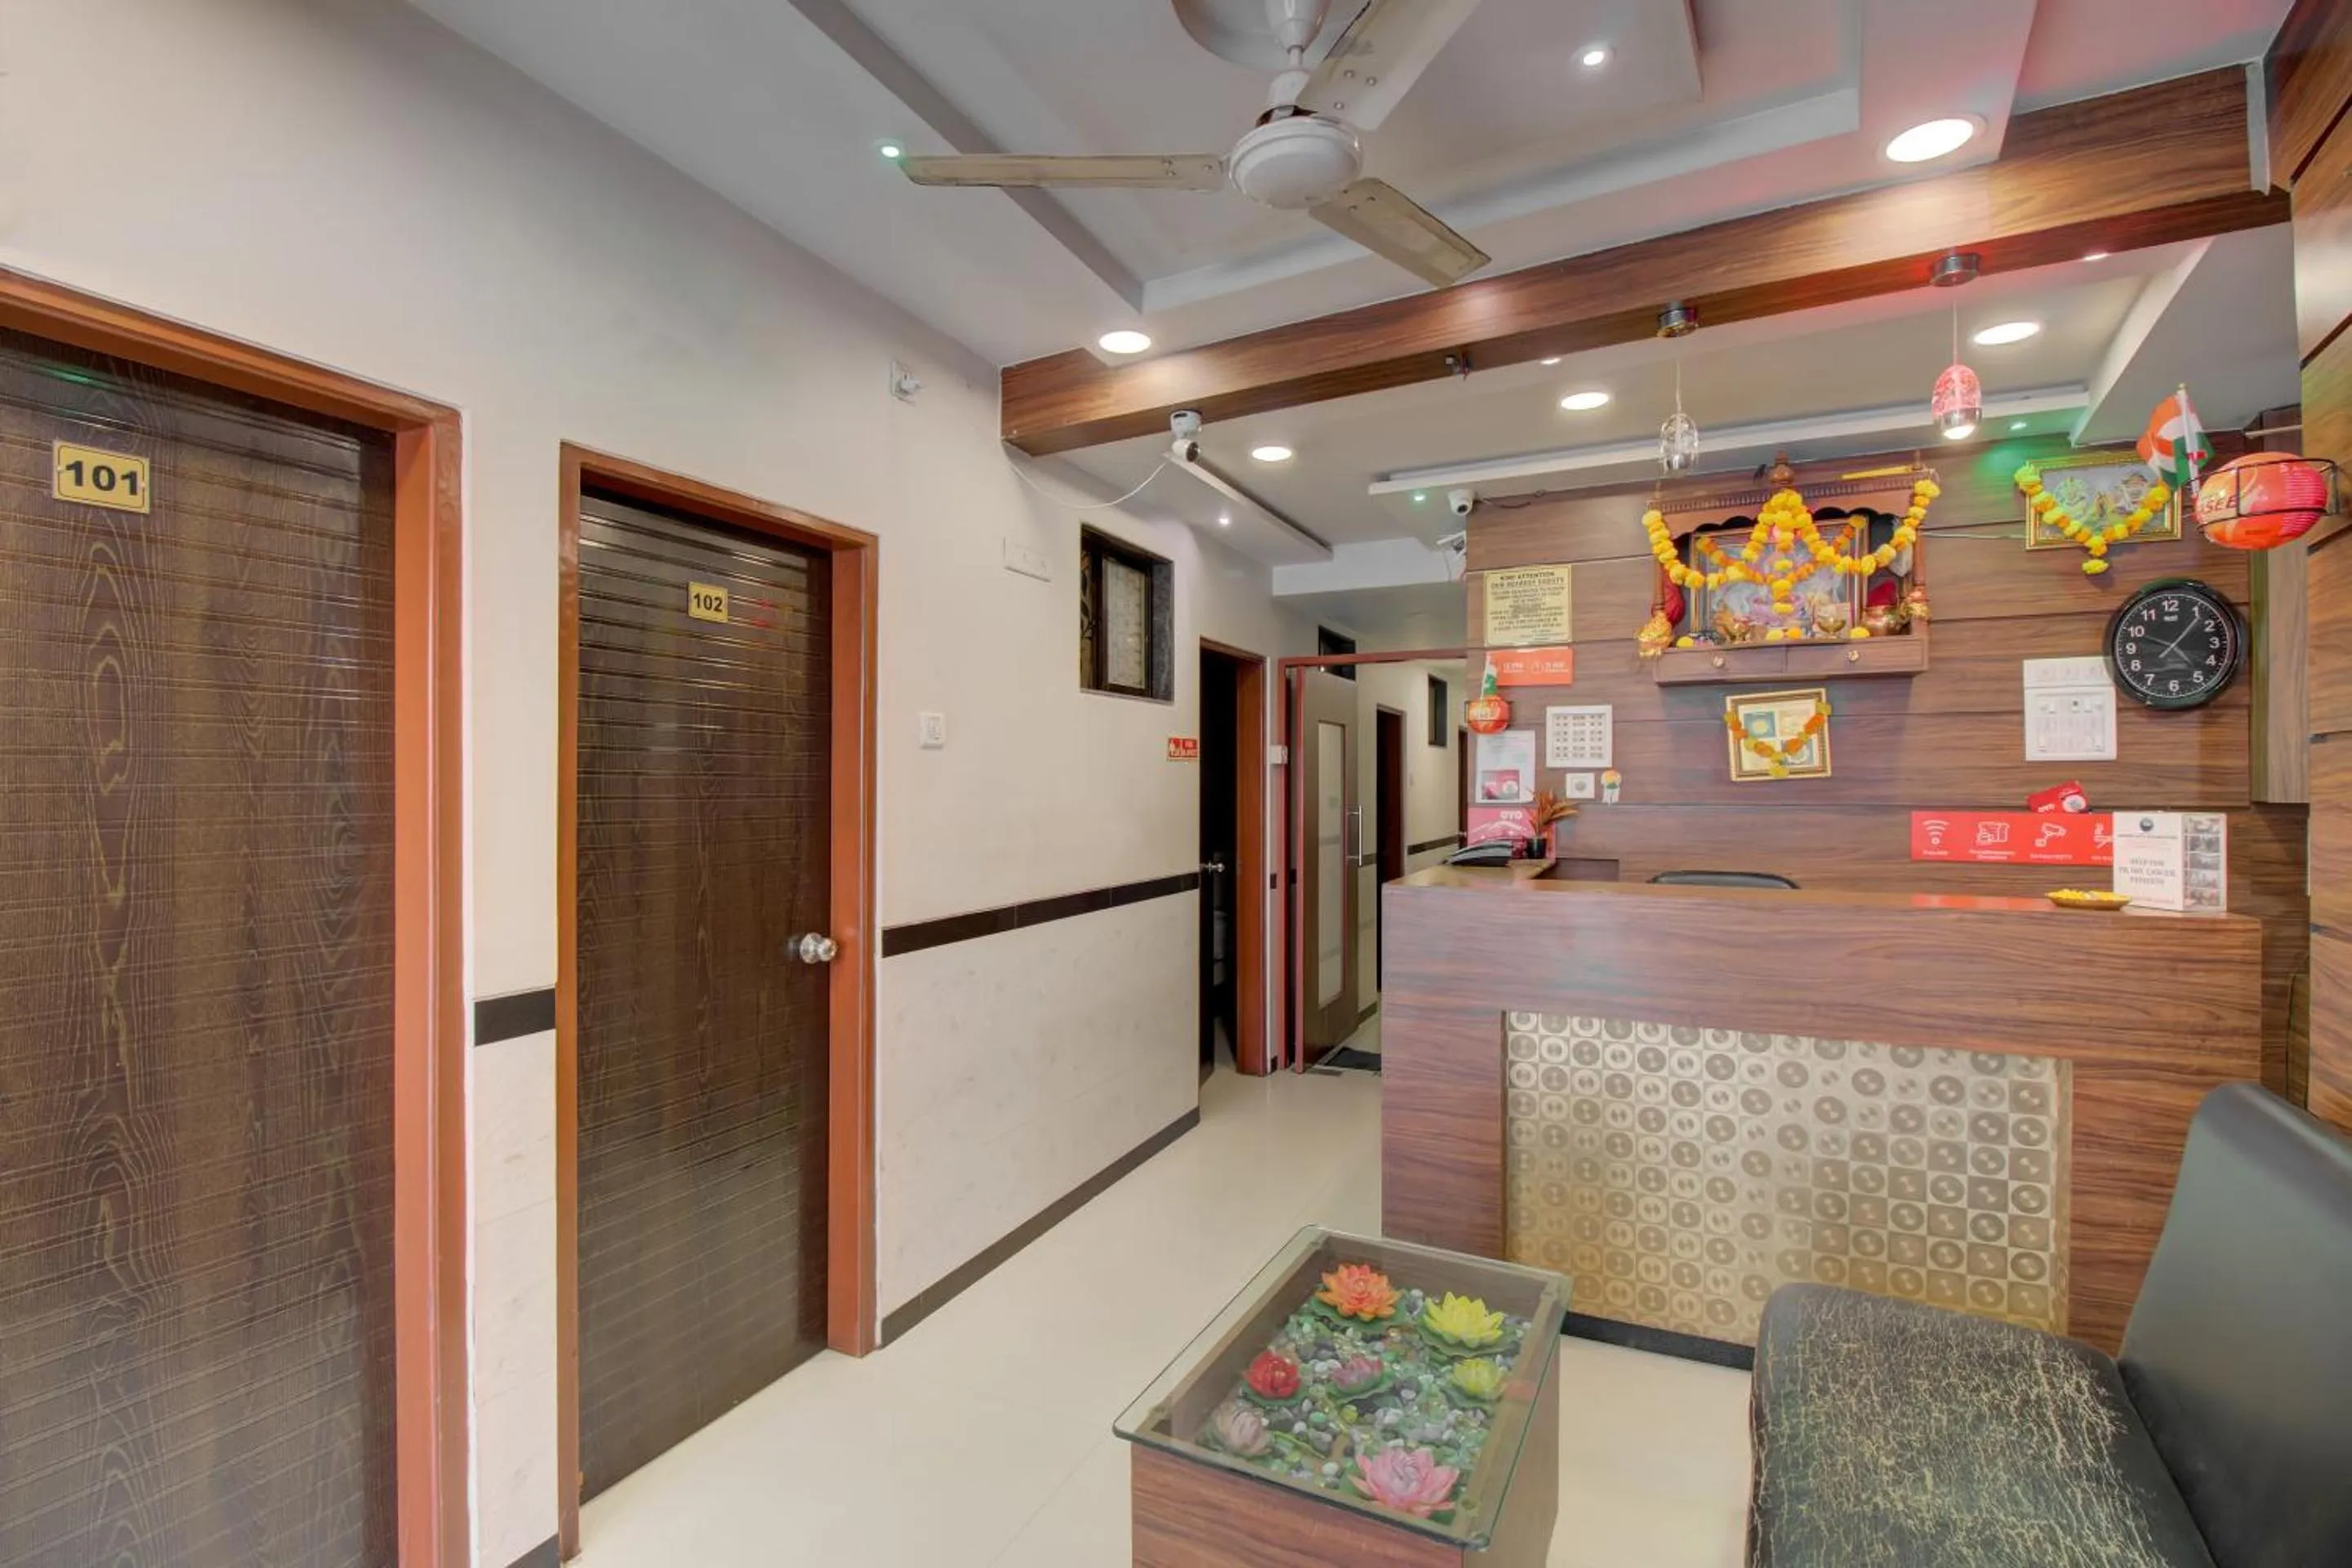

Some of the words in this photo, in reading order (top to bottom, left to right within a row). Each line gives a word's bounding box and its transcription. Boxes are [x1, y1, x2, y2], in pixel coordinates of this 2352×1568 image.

[65, 459, 139, 497] 101
[693, 592, 724, 613] 102
[2162, 599, 2179, 612] 12
[2140, 609, 2157, 621] 11
[2192, 607, 2200, 617] 1
[2127, 626, 2145, 638] 10
[2204, 620, 2216, 632] 2
[2125, 643, 2136, 655] 9
[2209, 637, 2221, 649] 3
[2131, 659, 2141, 671] 8
[2205, 654, 2216, 666] 4
[2145, 673, 2155, 686] 7
[2193, 670, 2204, 684] 5
[2169, 679, 2180, 693] 6
[1499, 810, 1523, 821] OYO
